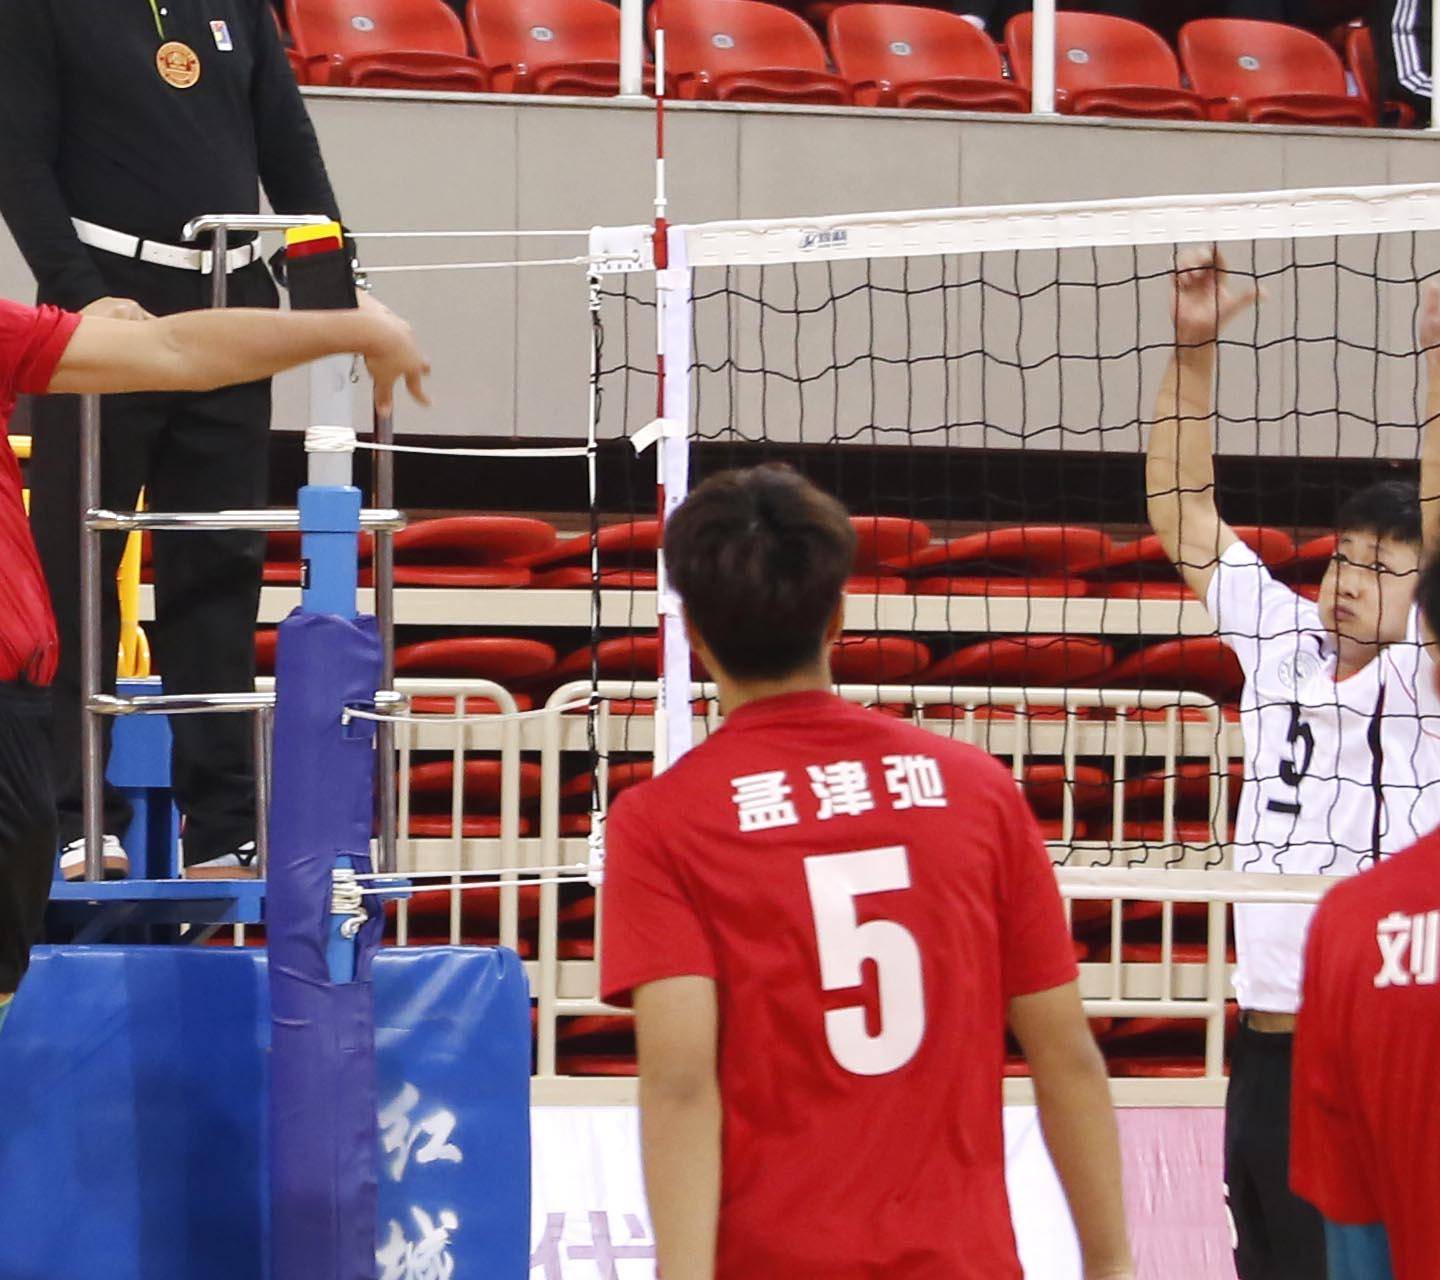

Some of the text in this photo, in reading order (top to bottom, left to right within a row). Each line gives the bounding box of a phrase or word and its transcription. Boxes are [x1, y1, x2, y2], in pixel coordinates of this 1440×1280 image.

[1278, 702, 1314, 787] 5
[731, 754, 948, 833] 孟津弛
[803, 845, 926, 1076] 5
